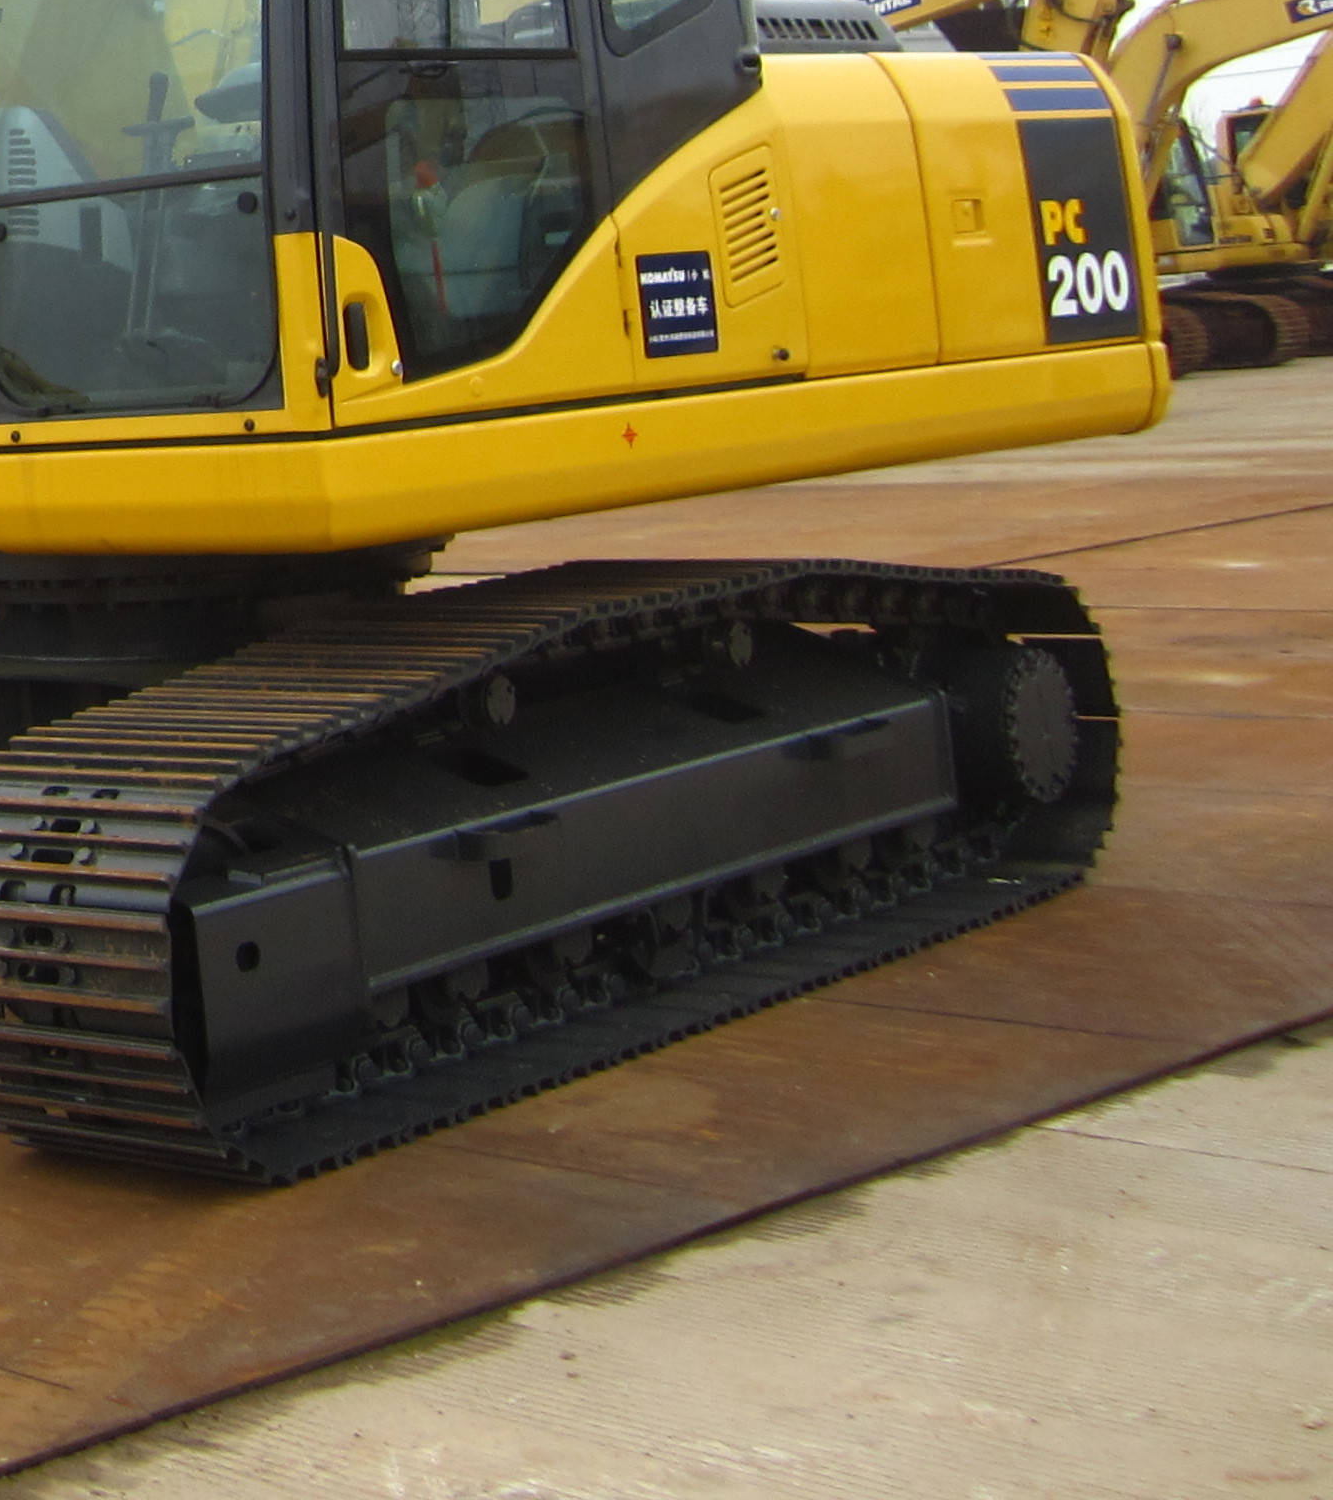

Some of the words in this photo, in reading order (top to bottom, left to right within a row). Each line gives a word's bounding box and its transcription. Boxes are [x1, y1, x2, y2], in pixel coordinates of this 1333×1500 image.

[1039, 198, 1088, 246] PC
[640, 267, 685, 285] KOMATSU
[1048, 249, 1129, 317] 200
